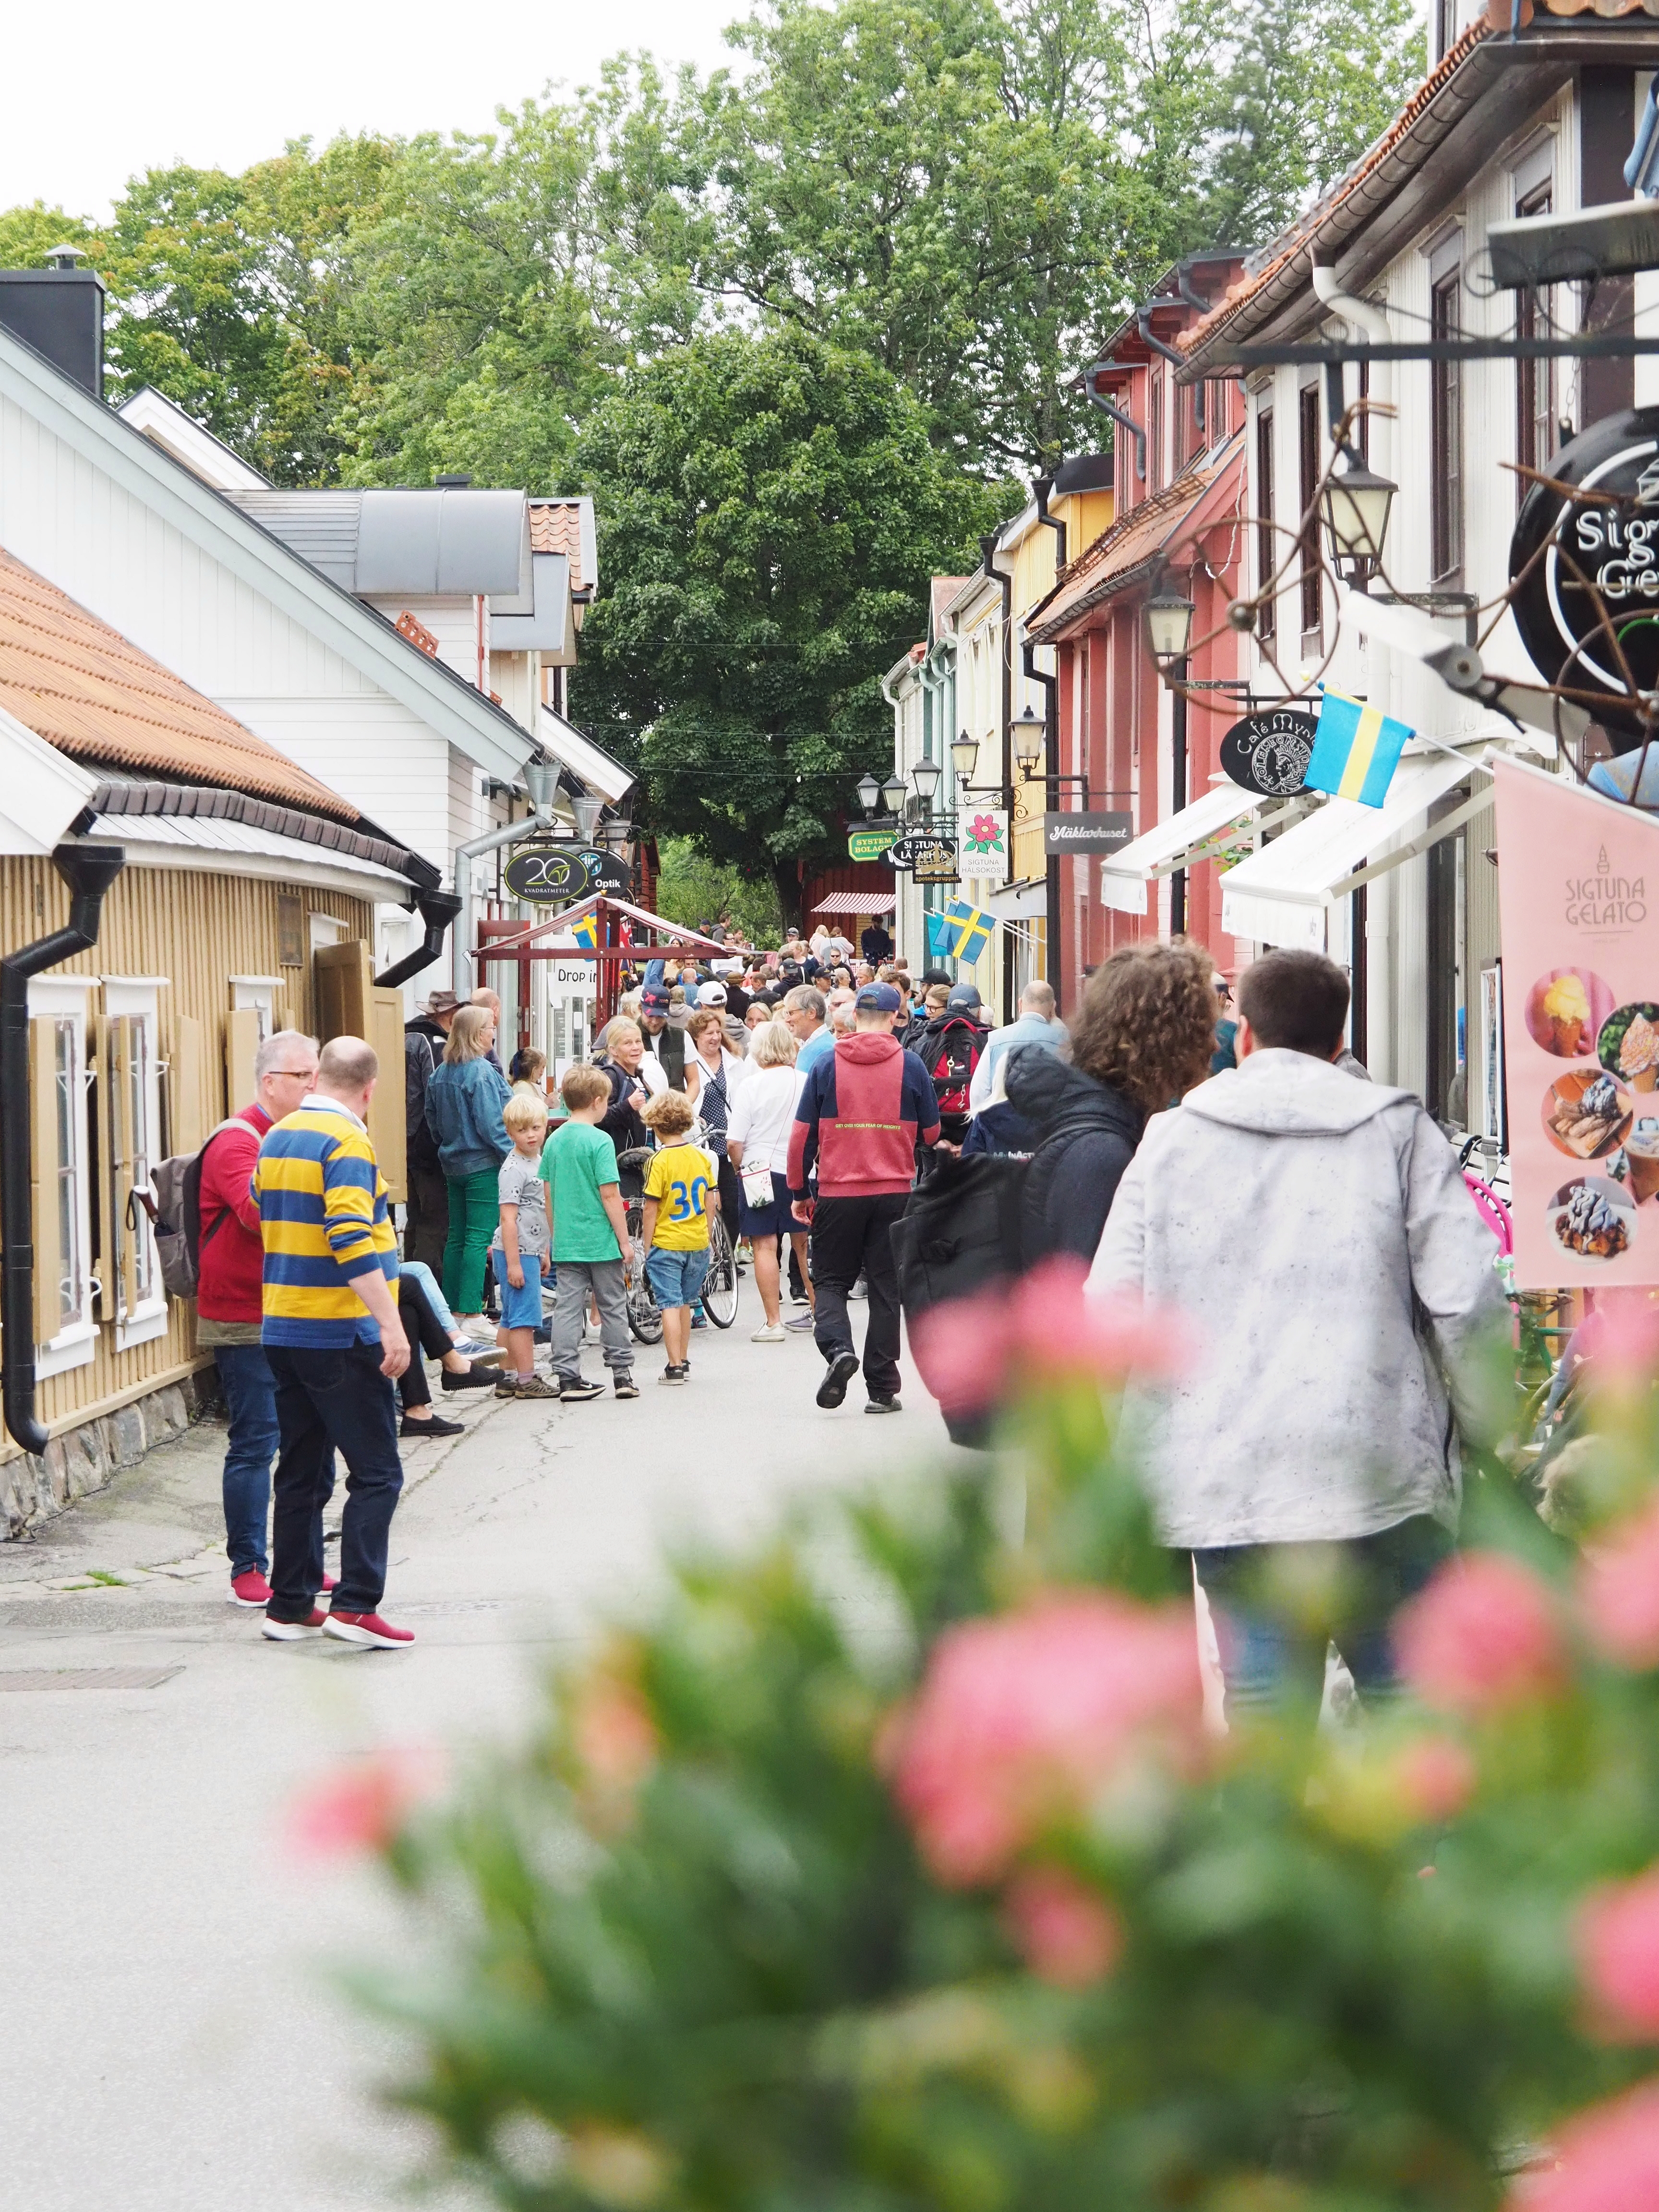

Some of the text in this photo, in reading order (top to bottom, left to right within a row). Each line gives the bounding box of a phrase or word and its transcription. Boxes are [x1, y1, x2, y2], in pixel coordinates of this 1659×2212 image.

[1597, 560, 1659, 599] Ge
[1237, 721, 1269, 754] Café
[856, 837, 892, 845] SYSTEM
[1049, 825, 1127, 841] Mäklarhuset
[854, 844, 892, 853] BOLAG
[904, 841, 944, 849] SIGTUNA
[525, 857, 571, 886] 20
[595, 879, 621, 889] Optik
[1565, 876, 1645, 901] SIGTUNA
[1565, 901, 1647, 926] GELATO
[558, 969, 586, 982] Drop
[669, 1176, 709, 1221] 30
